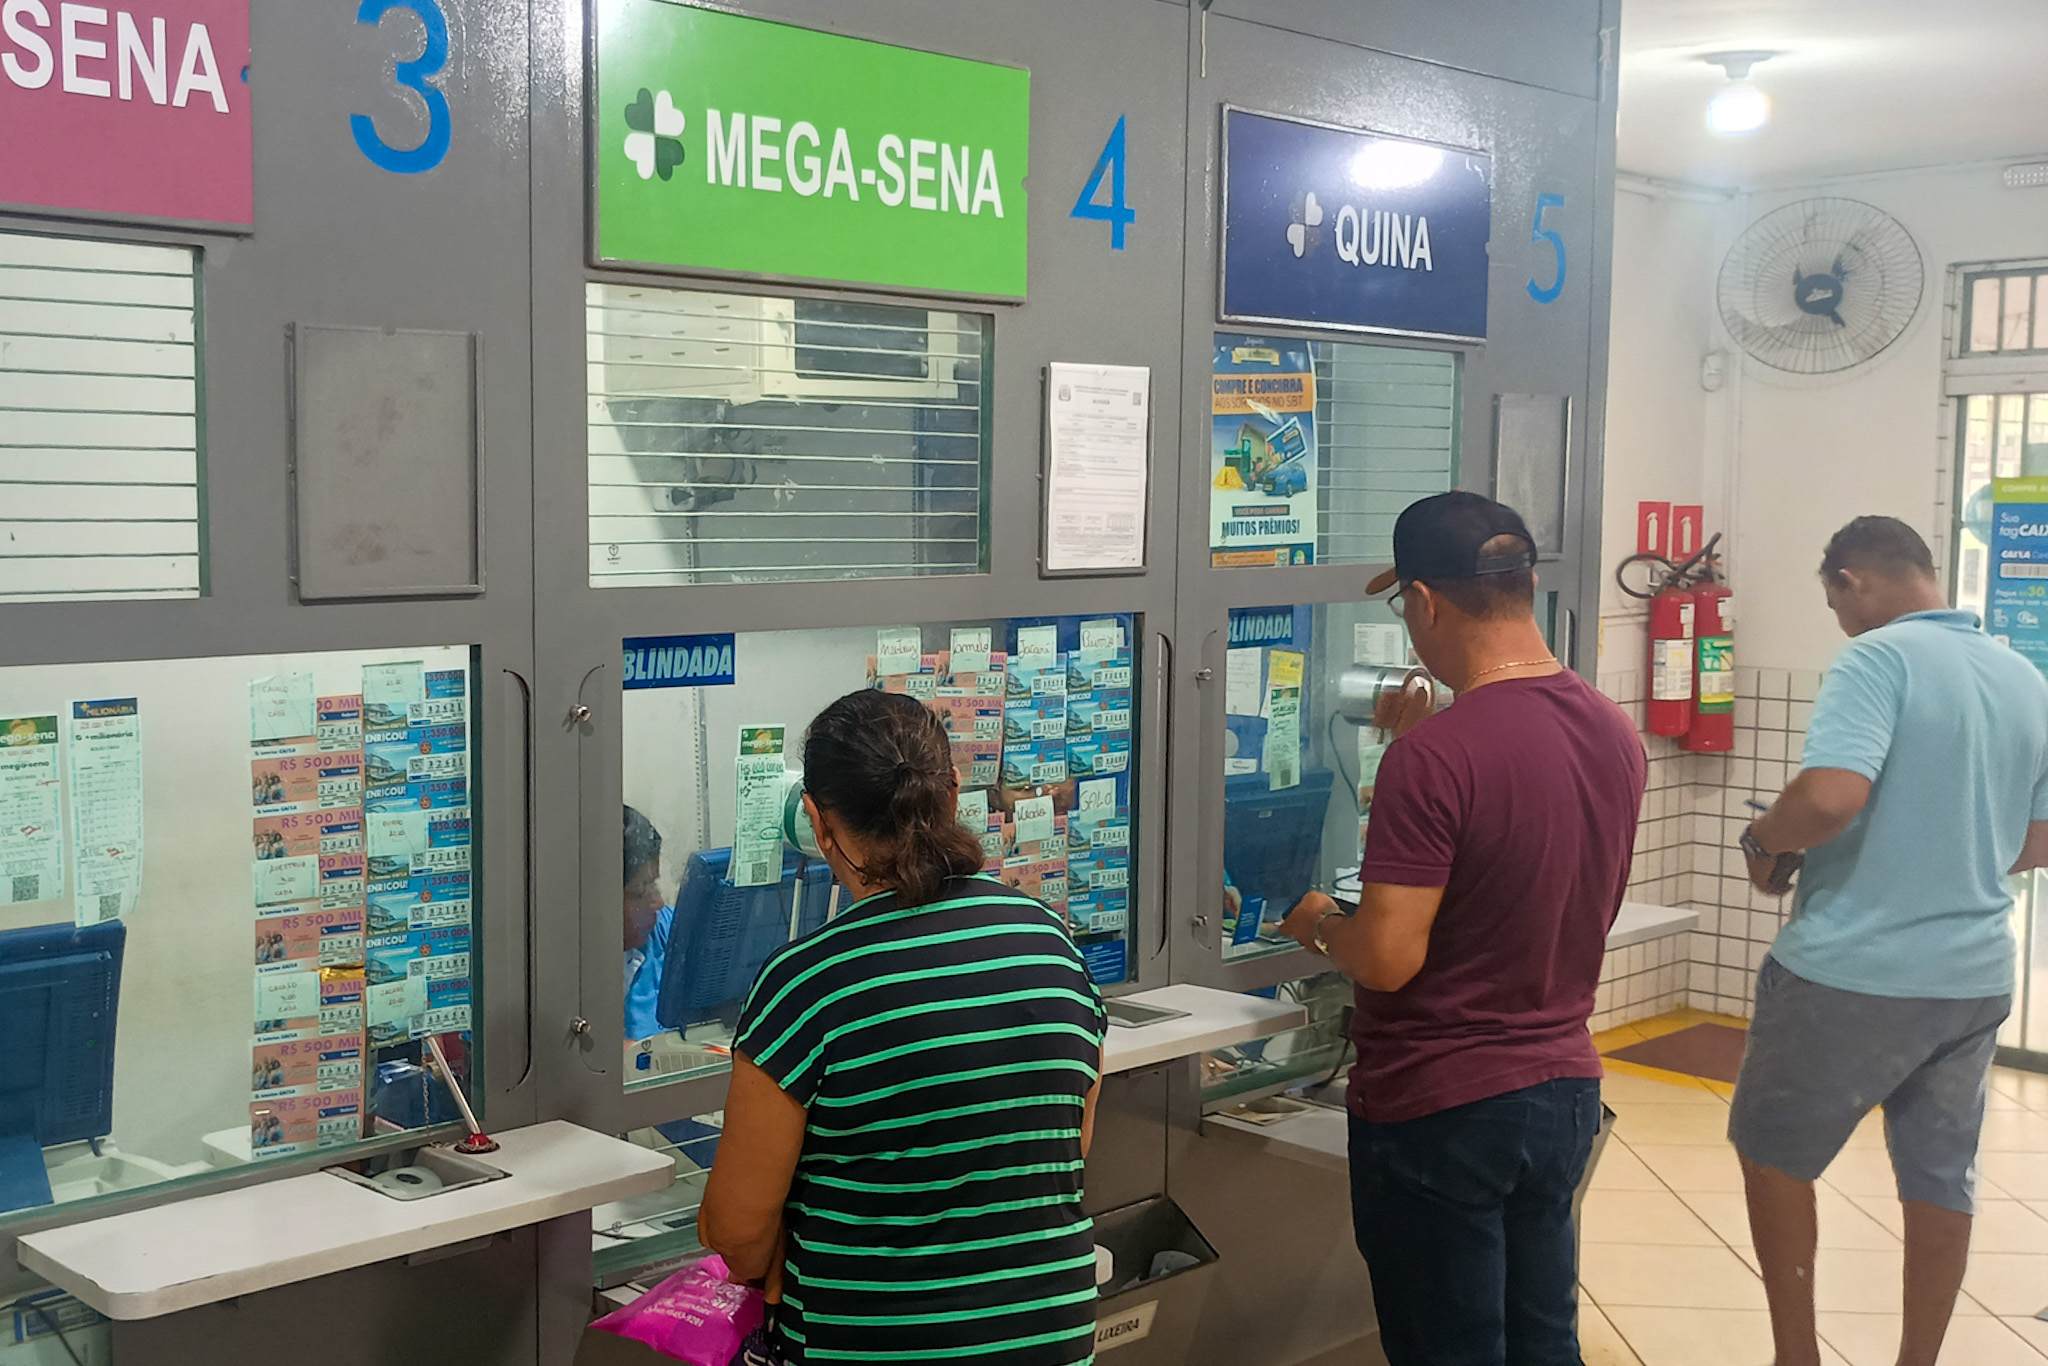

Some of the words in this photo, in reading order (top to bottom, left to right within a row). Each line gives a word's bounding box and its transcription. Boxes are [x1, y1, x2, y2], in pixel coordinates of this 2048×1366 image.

[0, 0, 229, 113] SENA
[350, 0, 452, 174] 3
[706, 108, 1004, 219] MEGA-SENA
[1070, 113, 1136, 250] 4
[1335, 204, 1433, 271] QUINA
[1526, 193, 1567, 304] 5
[2001, 512, 2020, 524] Sua
[1222, 520, 1257, 537] MUITOS
[1259, 517, 1300, 536] PRÊMIOS!
[623, 643, 733, 682] BLINDADA
[338, 697, 361, 709] MIL
[966, 699, 984, 708] 500
[988, 699, 1003, 708] MIL
[365, 730, 408, 743] ENRICOU!
[964, 743, 981, 752] 500
[985, 743, 1000, 752] MIL
[304, 756, 333, 768] 500
[338, 754, 362, 765] MIL
[366, 785, 407, 799] ENRICOU!
[305, 812, 333, 826] 500
[339, 809, 362, 822] MIL
[341, 854, 365, 867] MIL
[1032, 863, 1050, 874] 500
[367, 880, 408, 893] ENRICOU!
[306, 913, 334, 927] 500
[339, 910, 364, 922] MIL
[366, 934, 408, 949] ENRICOU!
[340, 980, 364, 992] MIL
[303, 1040, 333, 1053] 500
[338, 1036, 362, 1048] MIL
[302, 1096, 332, 1109] 500
[336, 1092, 360, 1104] MIL
[1097, 1317, 1140, 1342] LIXEIRA
